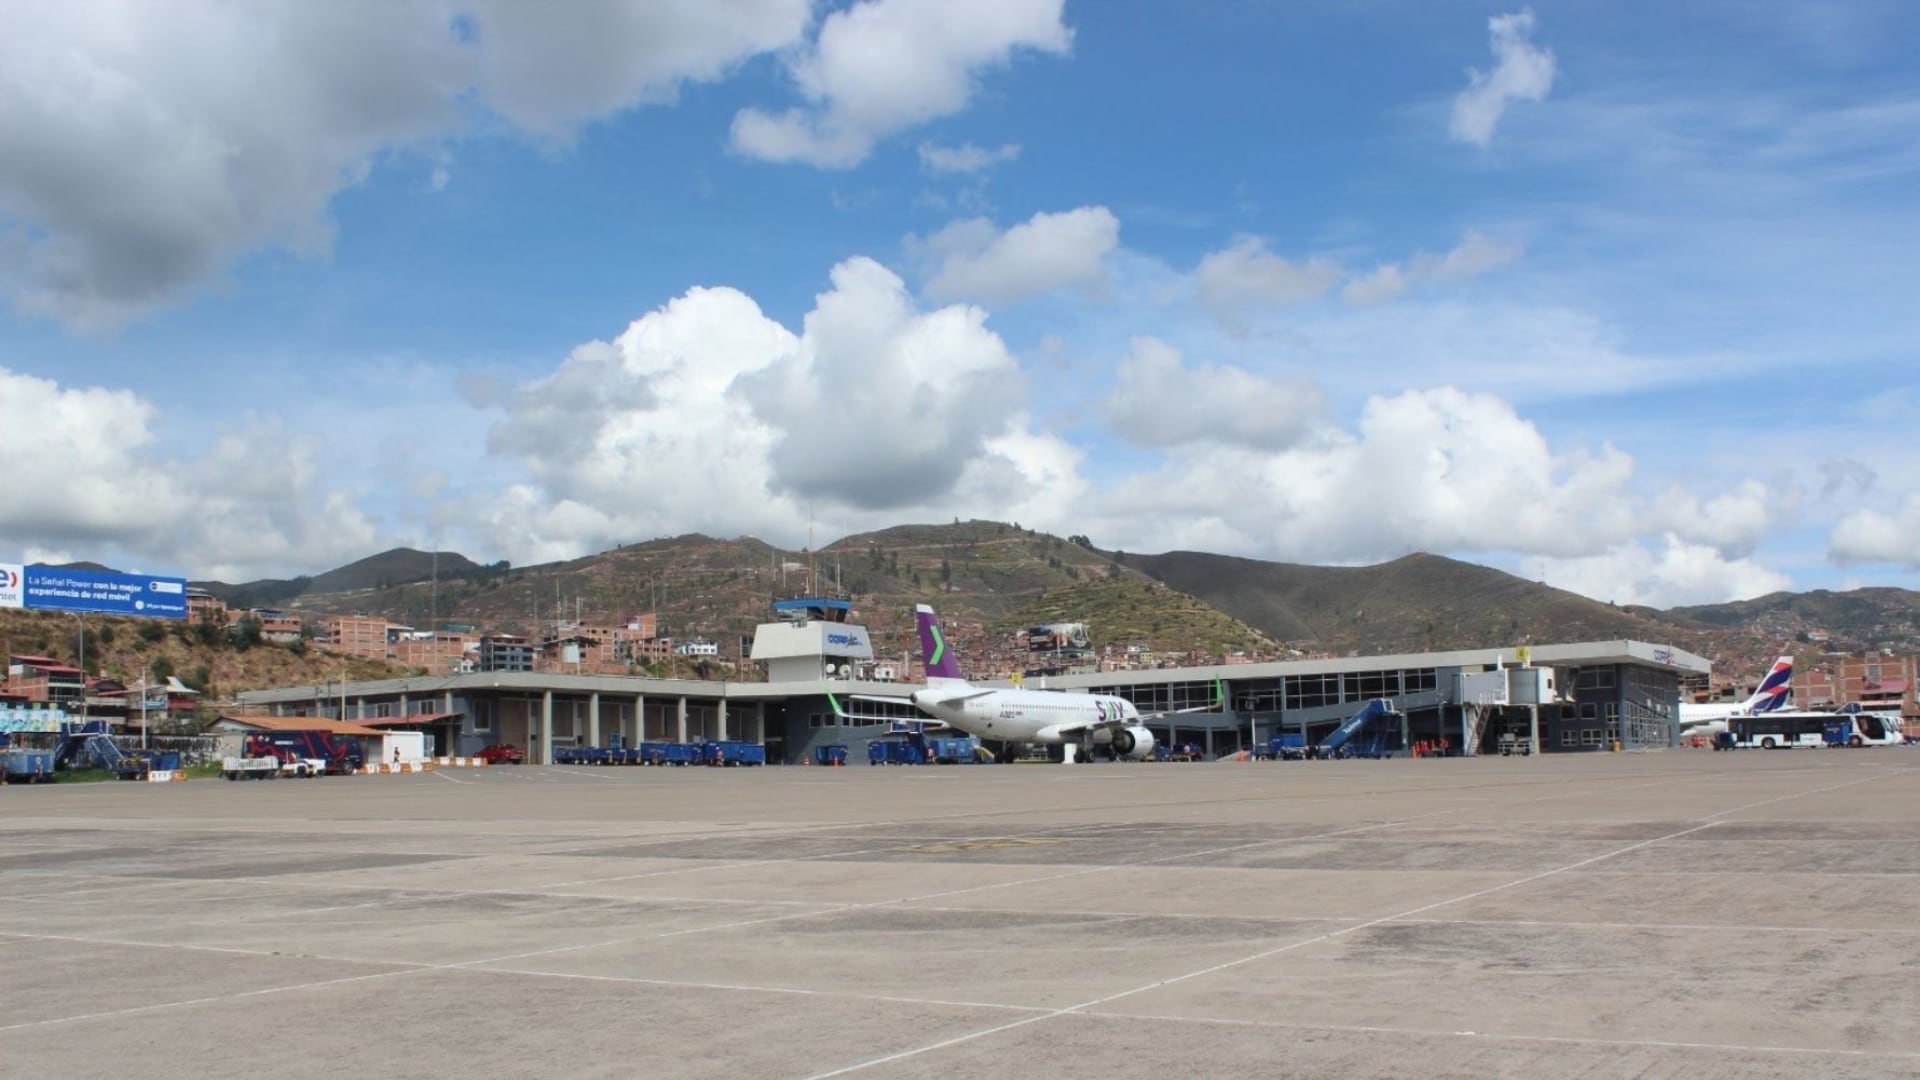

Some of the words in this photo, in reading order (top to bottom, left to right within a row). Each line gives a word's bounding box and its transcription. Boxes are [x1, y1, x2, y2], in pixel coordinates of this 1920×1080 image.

[28, 576, 40, 585] La
[41, 576, 65, 587] Señal
[66, 578, 91, 588] Power
[92, 582, 108, 590] con
[119, 583, 143, 594] mejor
[28, 587, 79, 598] experiencia
[81, 590, 91, 599] de
[92, 591, 107, 600] red
[108, 592, 130, 601] móvil
